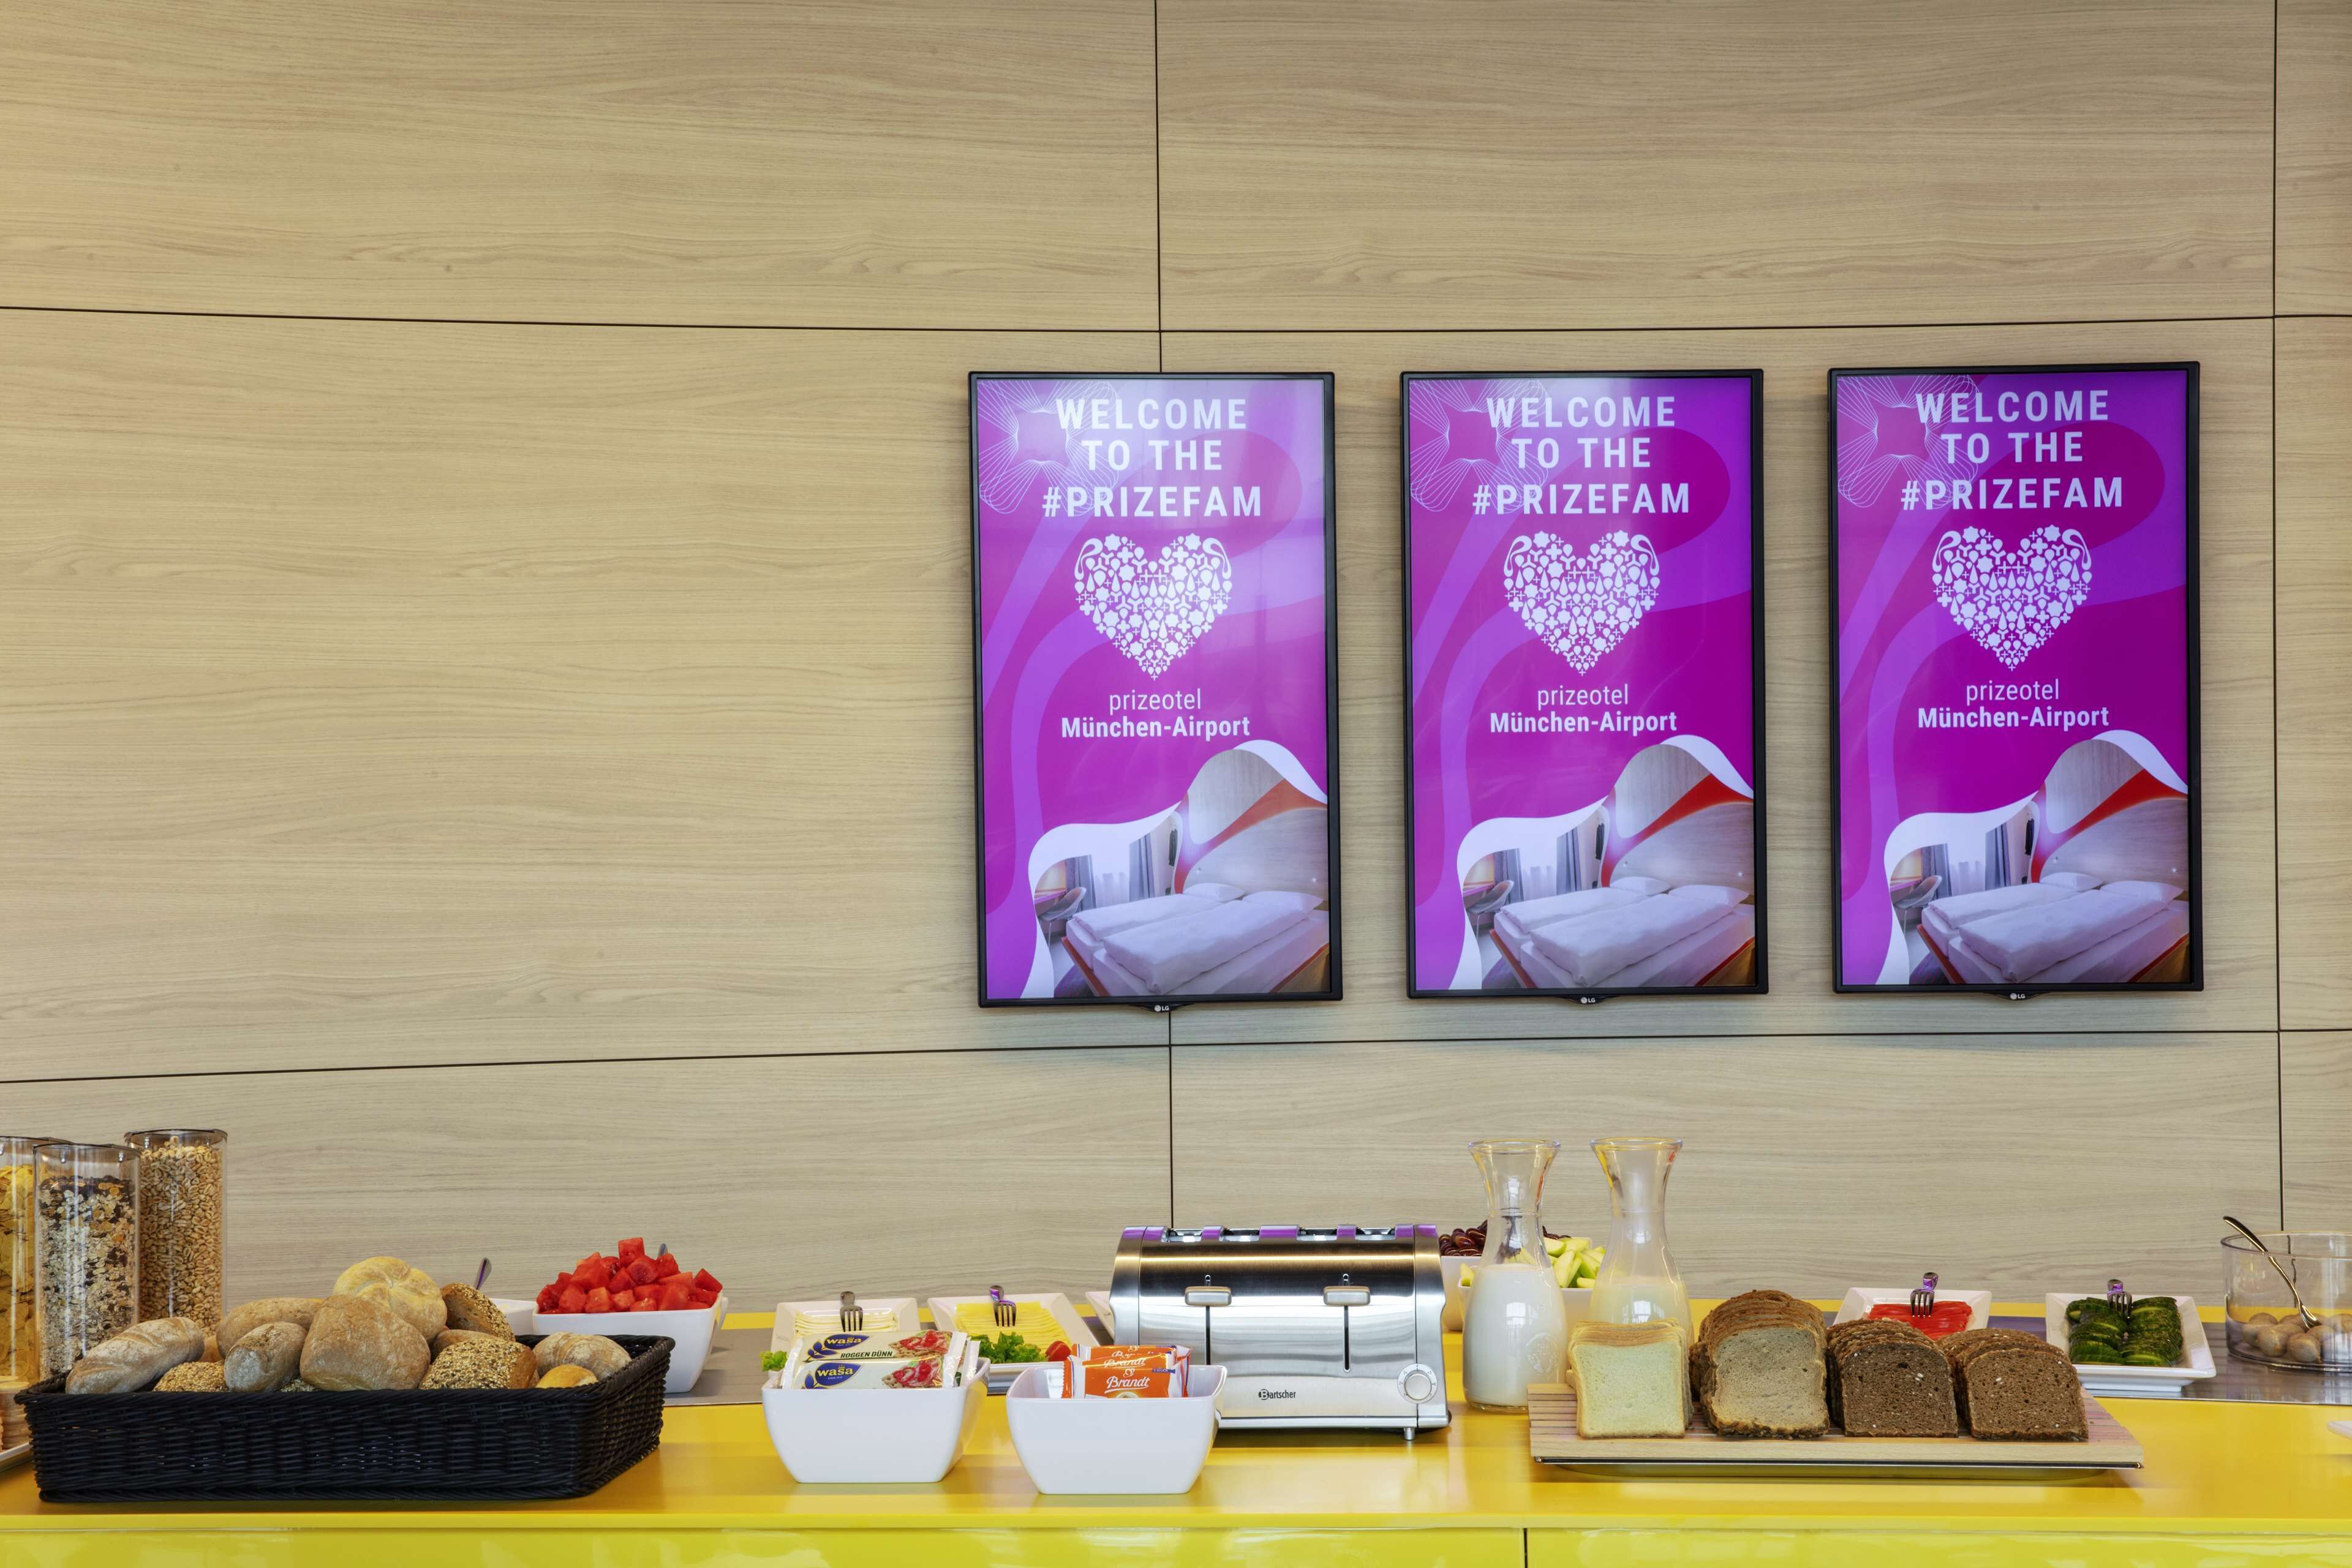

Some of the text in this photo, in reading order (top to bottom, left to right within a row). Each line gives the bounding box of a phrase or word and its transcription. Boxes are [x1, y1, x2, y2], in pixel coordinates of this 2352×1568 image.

[1055, 398, 1246, 431] WELCOME
[1487, 396, 1675, 428] WELCOME
[1915, 390, 2108, 423] WELCOME
[1082, 440, 1223, 470] TO THE
[1512, 438, 1651, 469] TO THE
[1941, 432, 2083, 464] TO THE
[1042, 486, 1262, 517] #PRIZEFAM
[1472, 483, 1689, 514] #PRIZEFAM
[1901, 477, 2123, 510] #PRIZEFAM
[1109, 688, 1202, 715] prizeotel
[1537, 684, 1629, 710] prizeotel
[1966, 679, 2059, 706] prizeotel
[1061, 716, 1250, 742] München-Airport
[1490, 711, 1677, 737] München-Airport
[1918, 706, 2109, 731] München-Airport
[816, 1366, 853, 1376] wasa
[1106, 1376, 1150, 1389] Brandt
[1258, 1389, 1296, 1401] Bartscher
